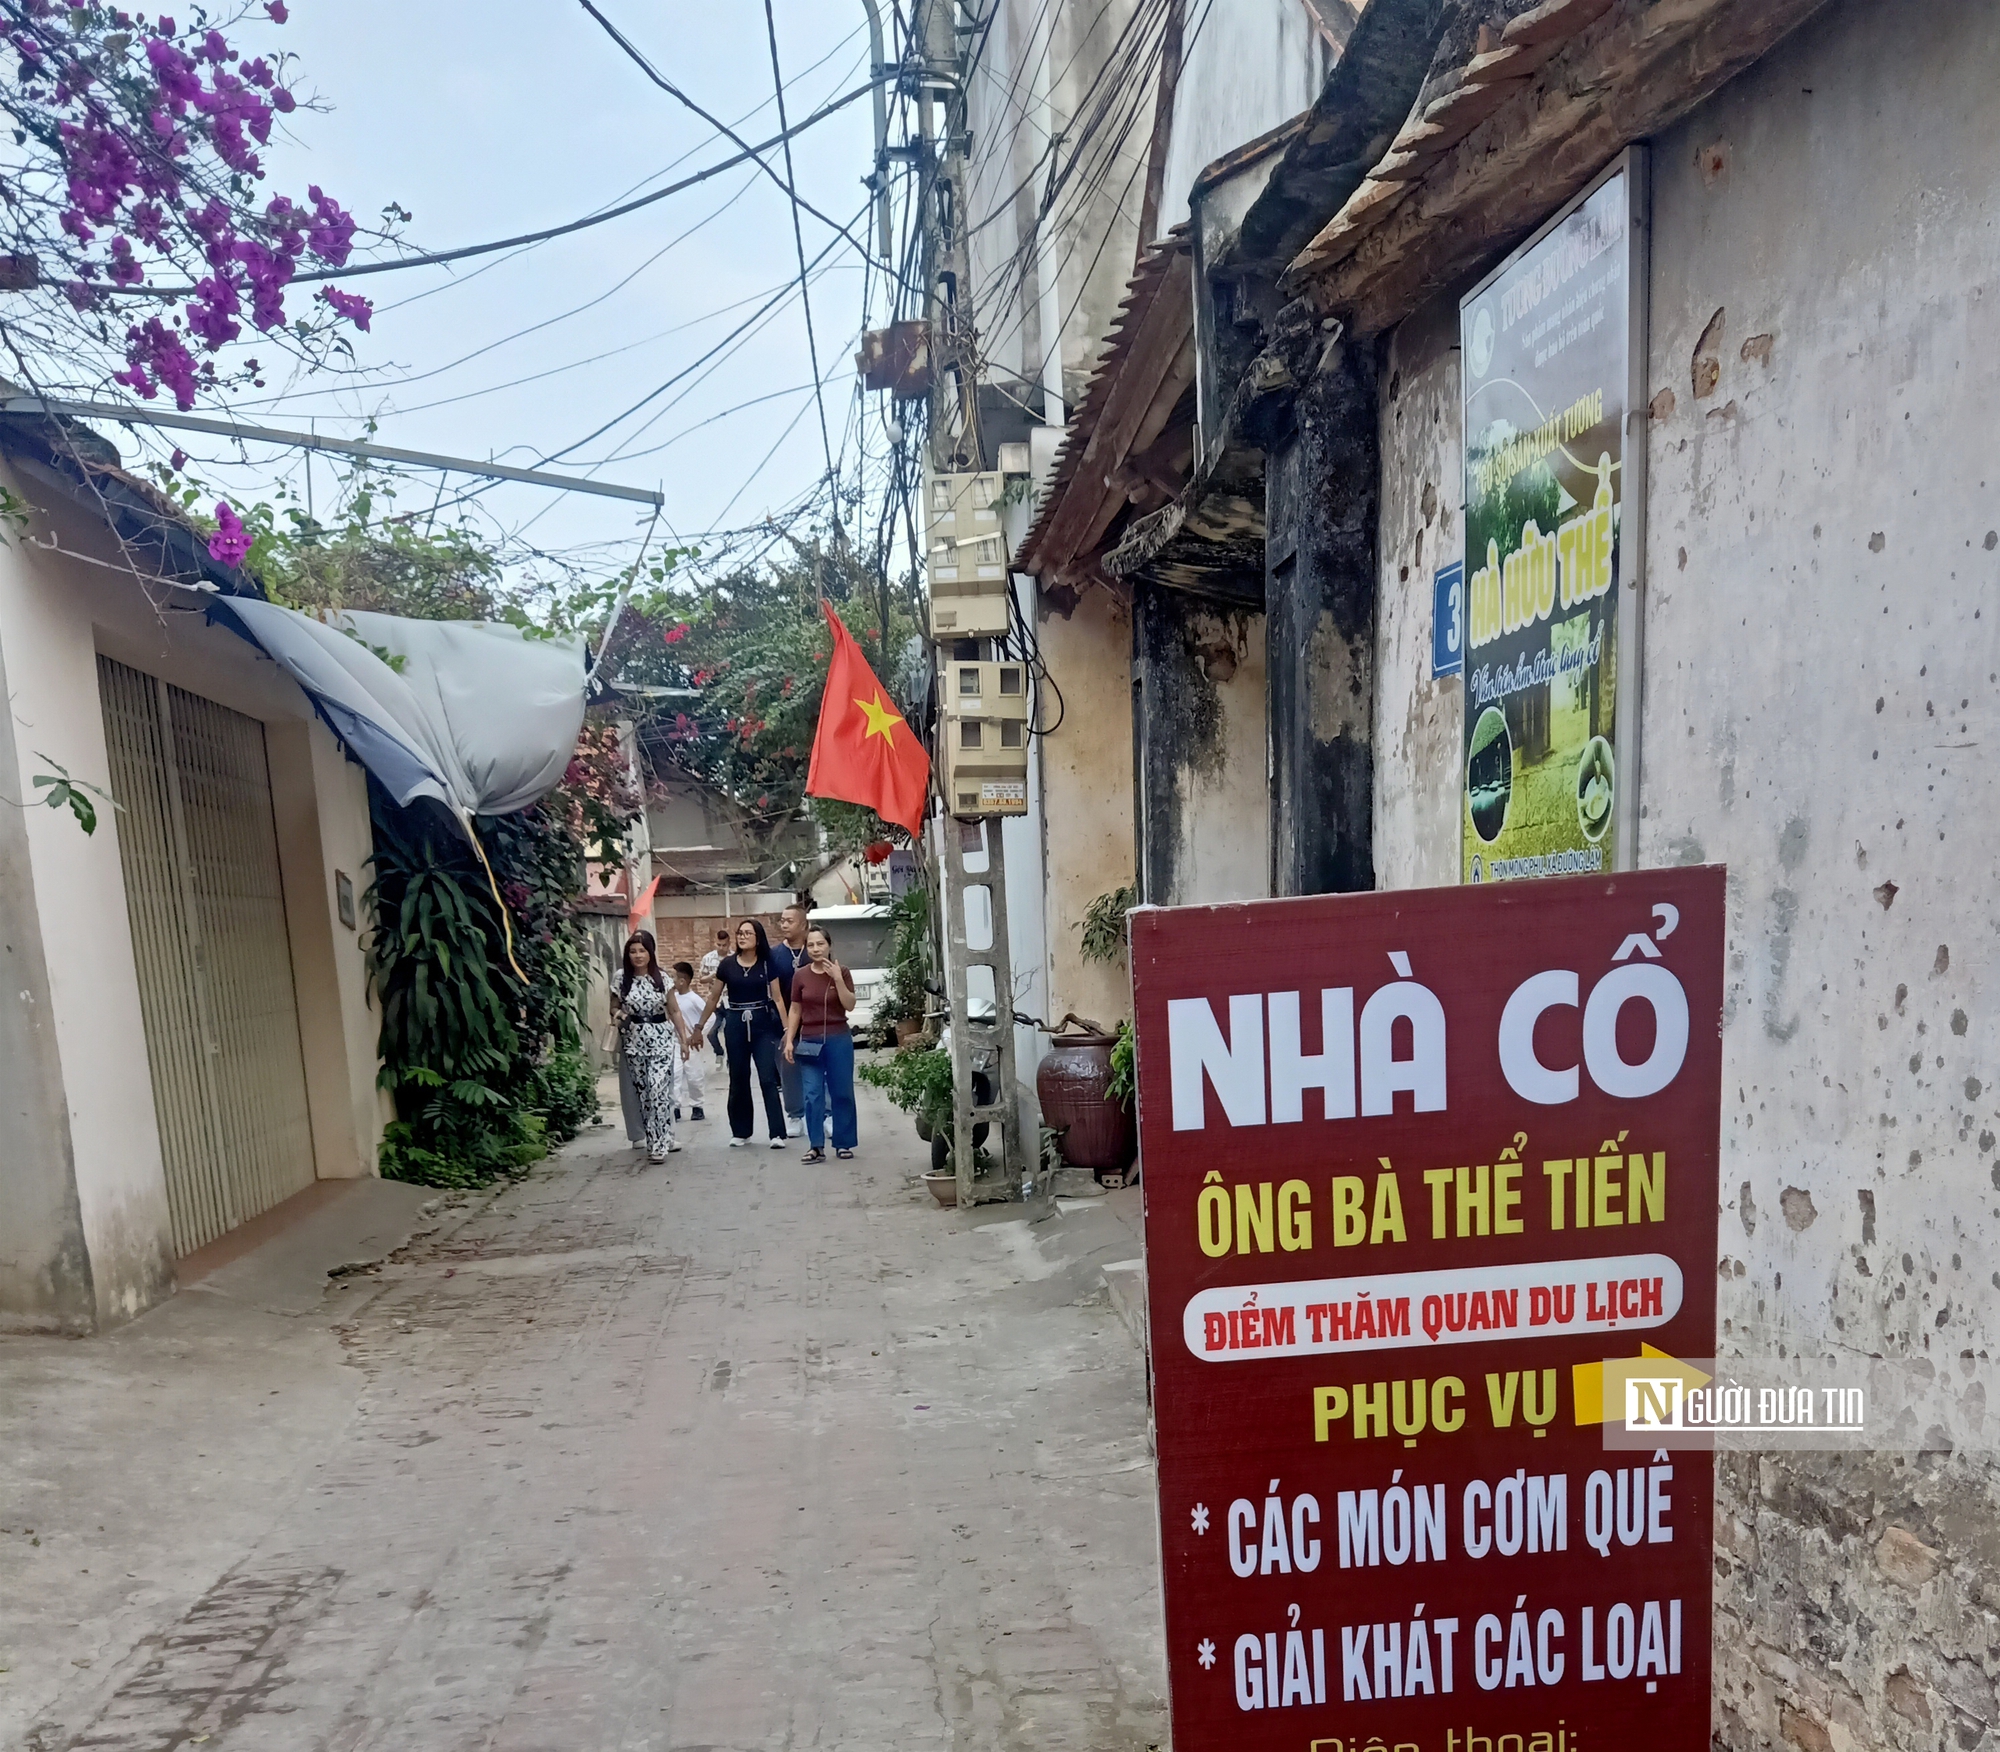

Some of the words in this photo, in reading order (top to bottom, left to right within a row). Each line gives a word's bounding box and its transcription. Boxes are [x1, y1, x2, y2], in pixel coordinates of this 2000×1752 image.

[1564, 387, 1602, 443] TƯƠNG
[1470, 537, 1502, 649] HÀ
[1503, 519, 1556, 635] HỮU
[1167, 950, 1447, 1132] NHÀ
[1498, 903, 1690, 1105] CỔ
[1197, 1169, 1312, 1258] ÔNG
[1332, 1157, 1407, 1247] BÀ
[1423, 1131, 1528, 1240] THỂ
[1543, 1129, 1667, 1231] TIẾN
[1204, 1291, 1297, 1352] ĐIỂM
[1305, 1291, 1411, 1344] THĂM
[1422, 1288, 1519, 1342] QUAN
[1529, 1284, 1576, 1326] DU
[1586, 1276, 1663, 1327] LỊCH
[1313, 1375, 1466, 1449] PHỤC
[1485, 1368, 1557, 1438] VỤ
[1226, 1478, 1321, 1579] CÁC
[1337, 1469, 1447, 1570] MÓN
[1463, 1468, 1568, 1560] CƠM
[1585, 1448, 1674, 1557] QUÊ
[1233, 1602, 1327, 1711] GIẢI
[1341, 1602, 1459, 1702] KHÁT
[1474, 1594, 1565, 1691] CÁC
[1581, 1598, 1682, 1694] LOẠI
